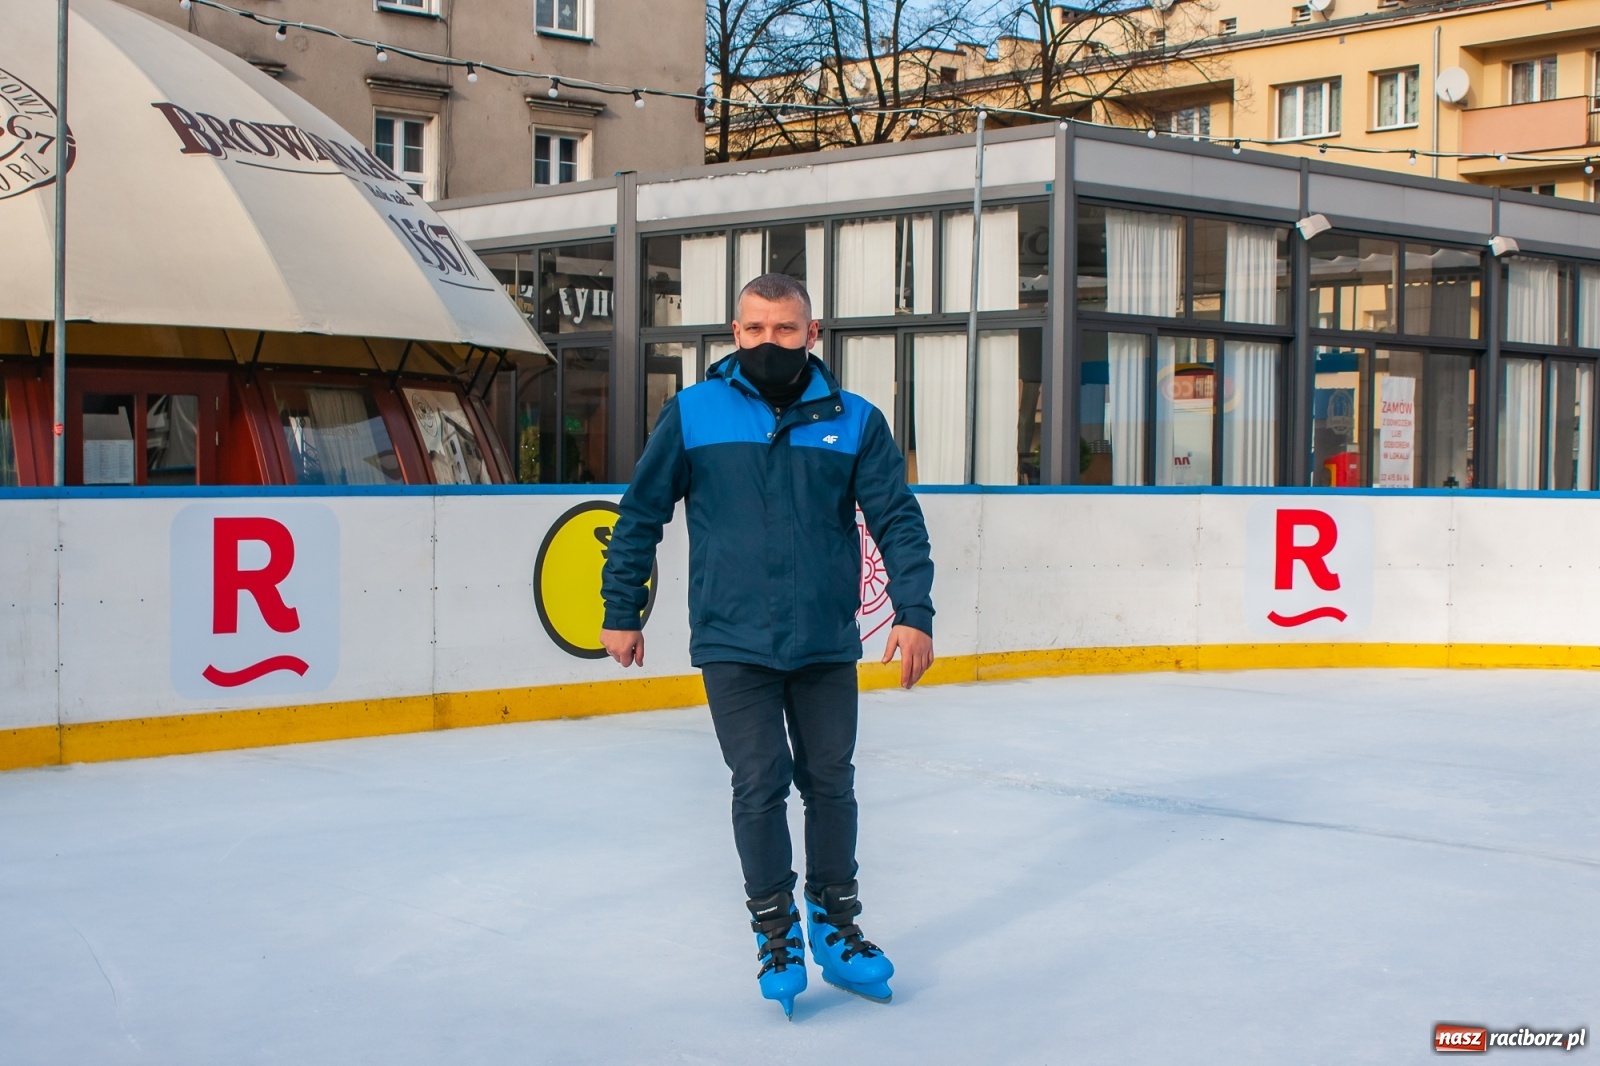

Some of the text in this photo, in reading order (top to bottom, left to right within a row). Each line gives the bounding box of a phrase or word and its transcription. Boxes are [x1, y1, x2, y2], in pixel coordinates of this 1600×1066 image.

[0, 74, 54, 118] OWY
[0, 114, 56, 154] 67
[151, 102, 350, 168] BROWAR
[388, 214, 479, 280] 1567
[1382, 400, 1412, 414] ZAMÓW
[823, 435, 839, 444] 4F
[213, 517, 300, 634] R
[1275, 509, 1341, 591] R
